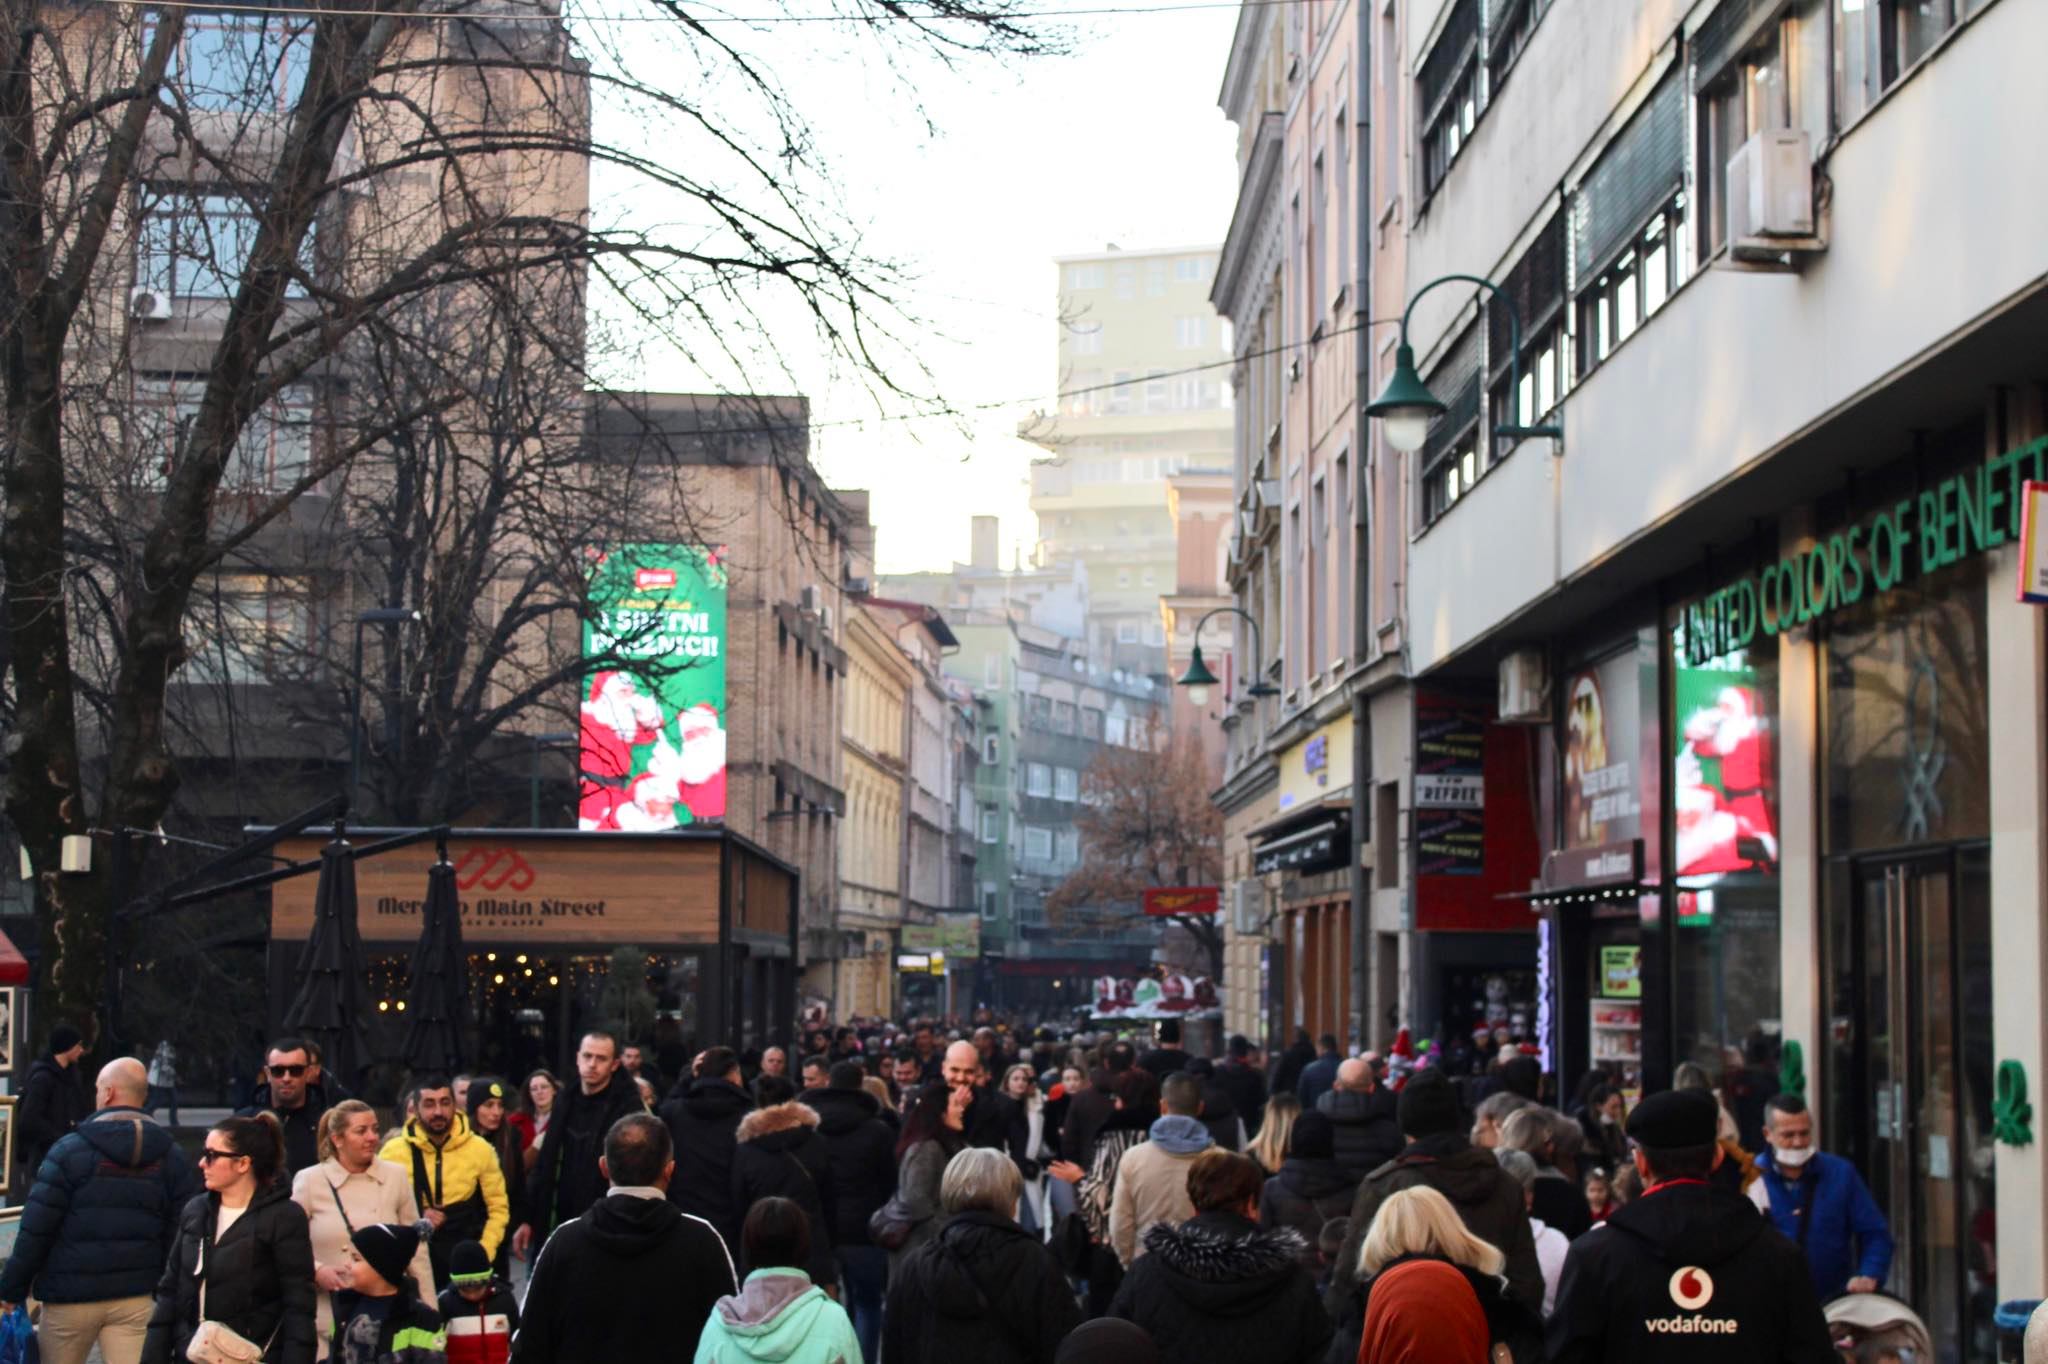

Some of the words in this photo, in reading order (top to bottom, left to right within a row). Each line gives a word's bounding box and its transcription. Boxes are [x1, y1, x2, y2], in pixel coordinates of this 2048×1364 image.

[1682, 579, 1756, 666] UNITED
[1760, 526, 1863, 635] COLORS
[1869, 502, 1914, 592] OF
[377, 897, 469, 915] Mero
[476, 898, 533, 916] Main
[540, 898, 607, 916] Street
[1645, 1314, 1738, 1334] vodafone
